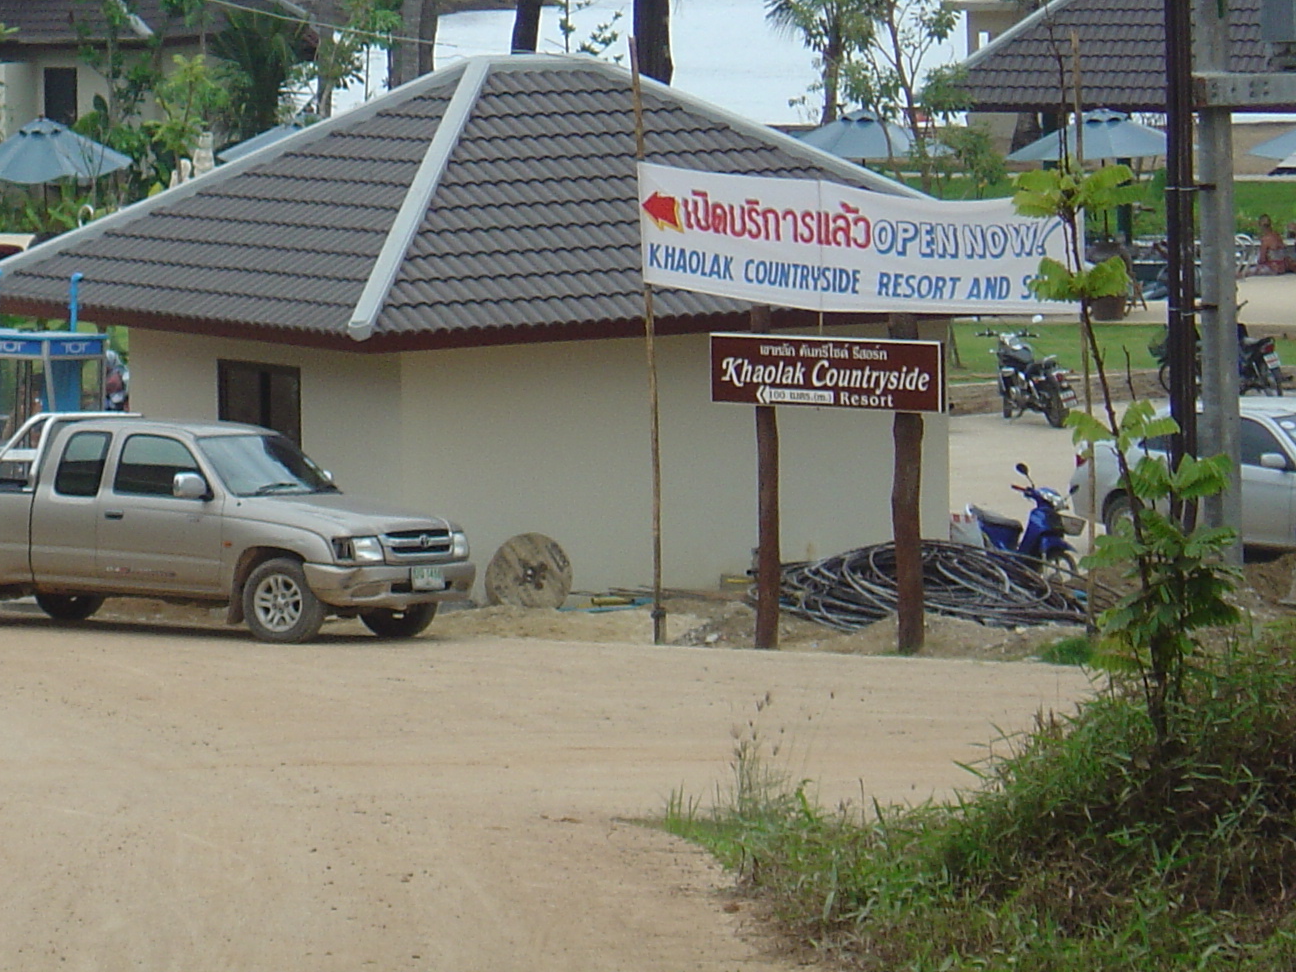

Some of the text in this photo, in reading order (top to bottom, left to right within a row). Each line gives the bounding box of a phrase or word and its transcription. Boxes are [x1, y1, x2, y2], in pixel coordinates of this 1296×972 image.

[682, 189, 871, 249] เปิดบริการแล้ว
[873, 219, 1062, 259] OPEN NOW!
[649, 242, 734, 282] KHAOLAK
[744, 259, 861, 294] COUNTRYSIDE
[877, 272, 961, 300] RESORT
[966, 276, 1011, 300] AND
[61, 342, 90, 354] TOT
[721, 357, 930, 394] Khaolak Countryside
[840, 392, 894, 408] Resort
